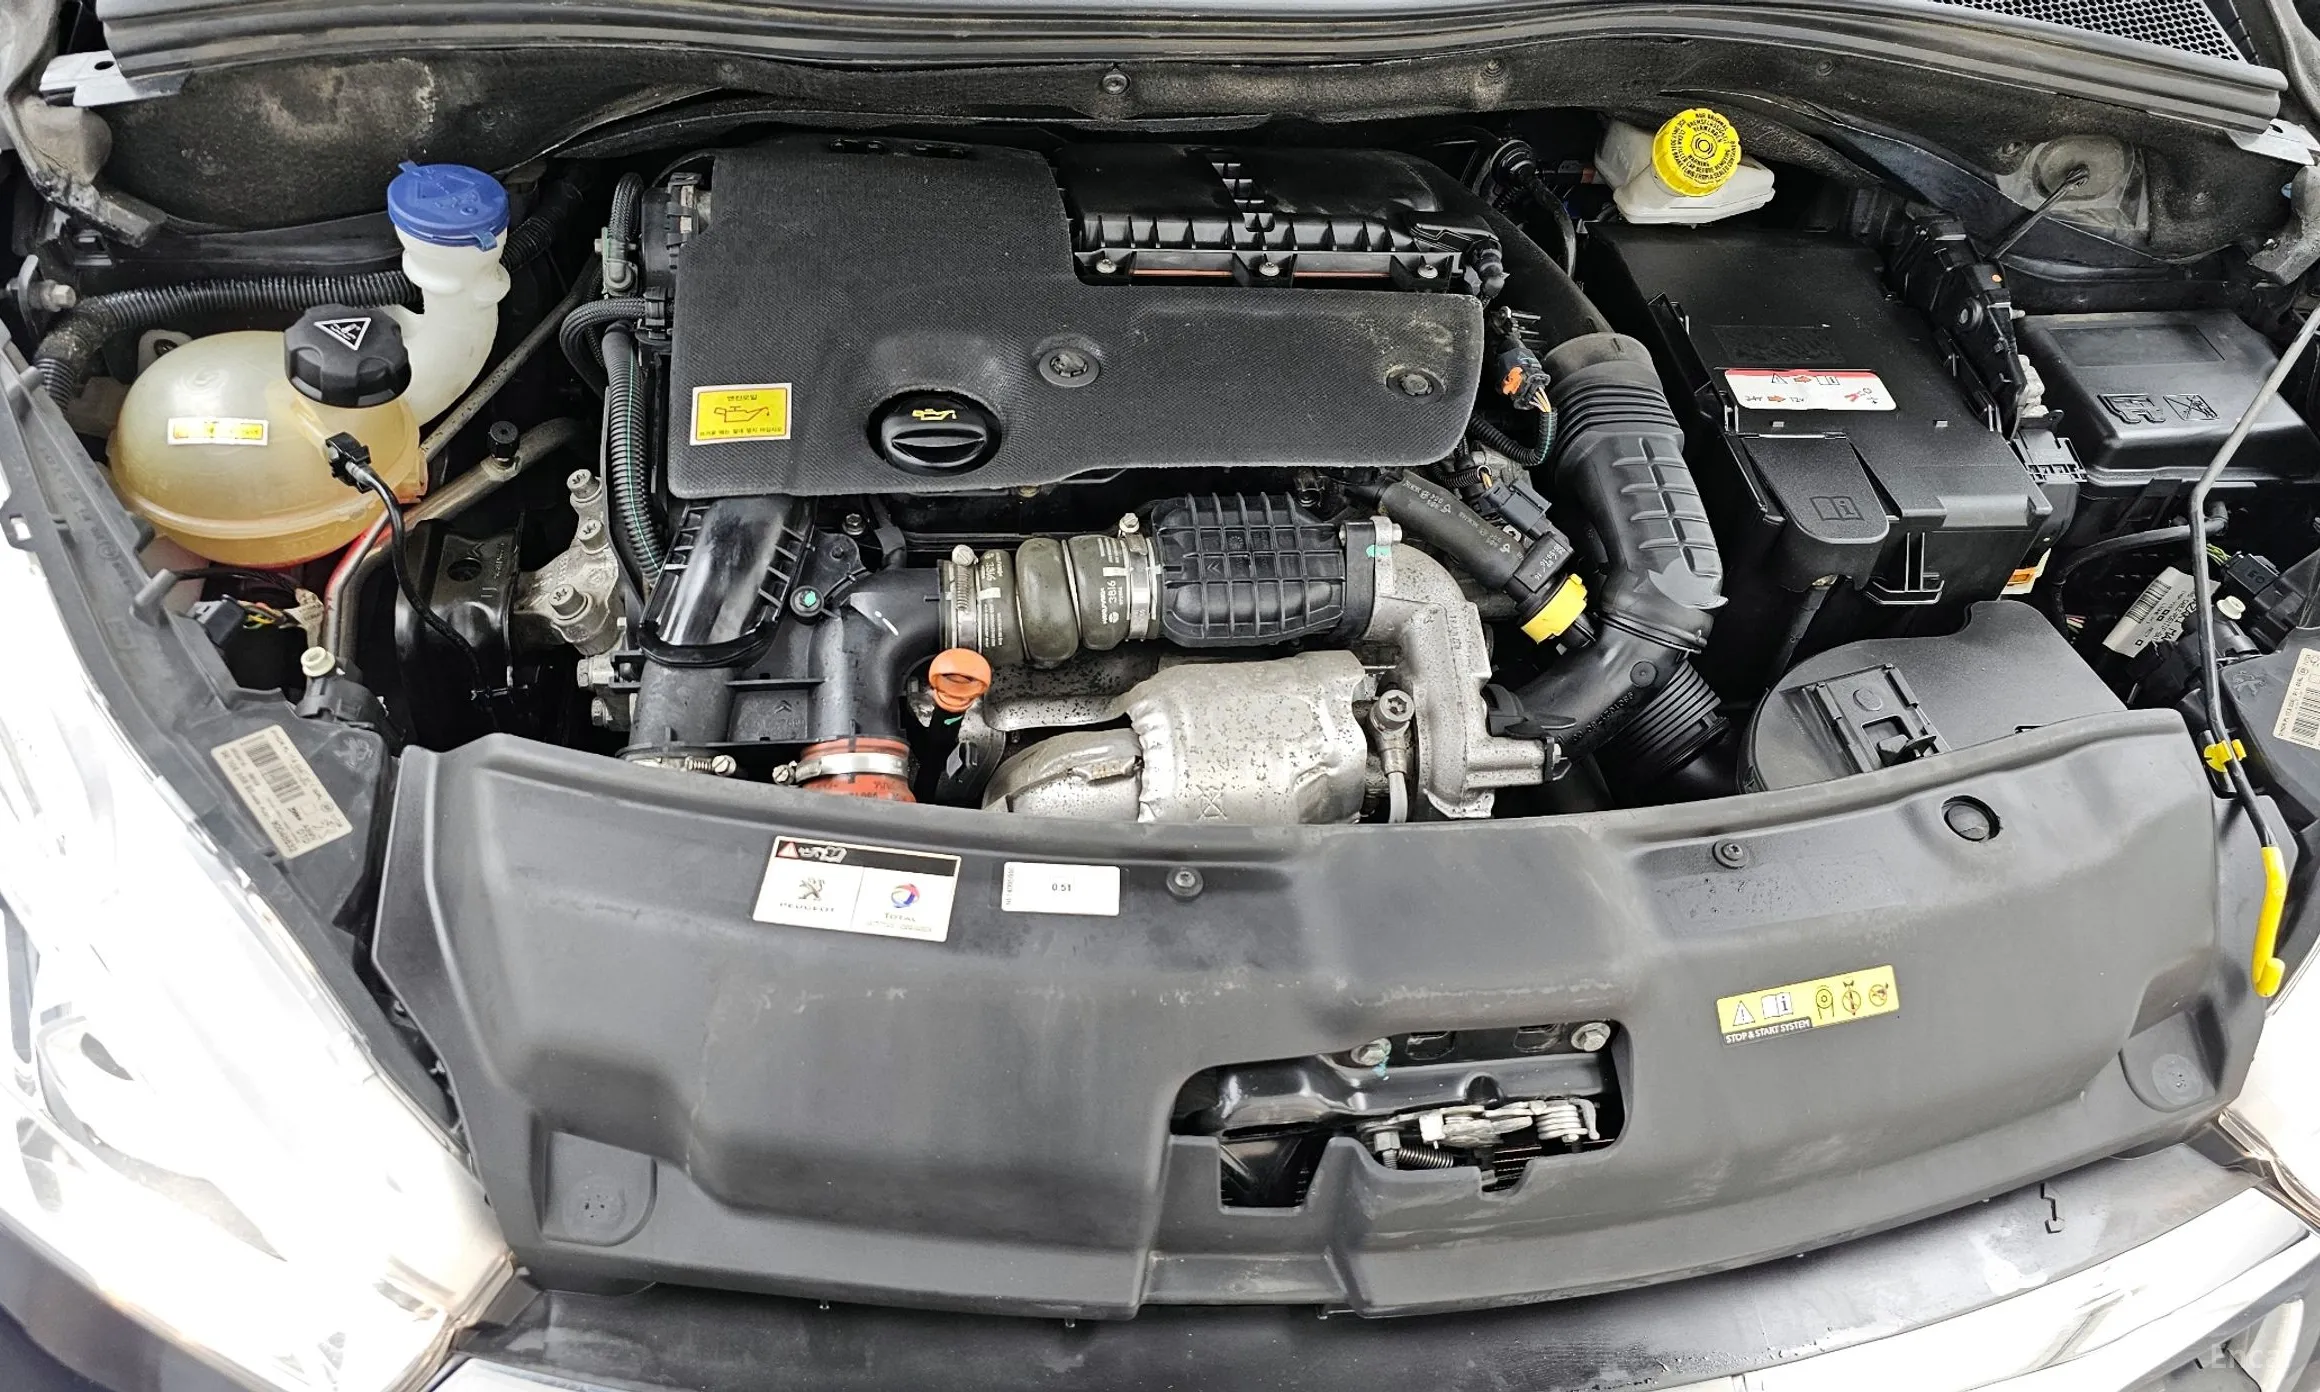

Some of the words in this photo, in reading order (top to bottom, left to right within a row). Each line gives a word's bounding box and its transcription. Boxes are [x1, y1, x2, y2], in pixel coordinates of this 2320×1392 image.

[1106, 580, 1117, 603] 3816
[884, 912, 916, 922] TOTAL
[1725, 1033, 1747, 1043] STOP
[1748, 1031, 1755, 1039] &
[1755, 1025, 1779, 1037] START
[1780, 1020, 1810, 1032] SYSTEM
